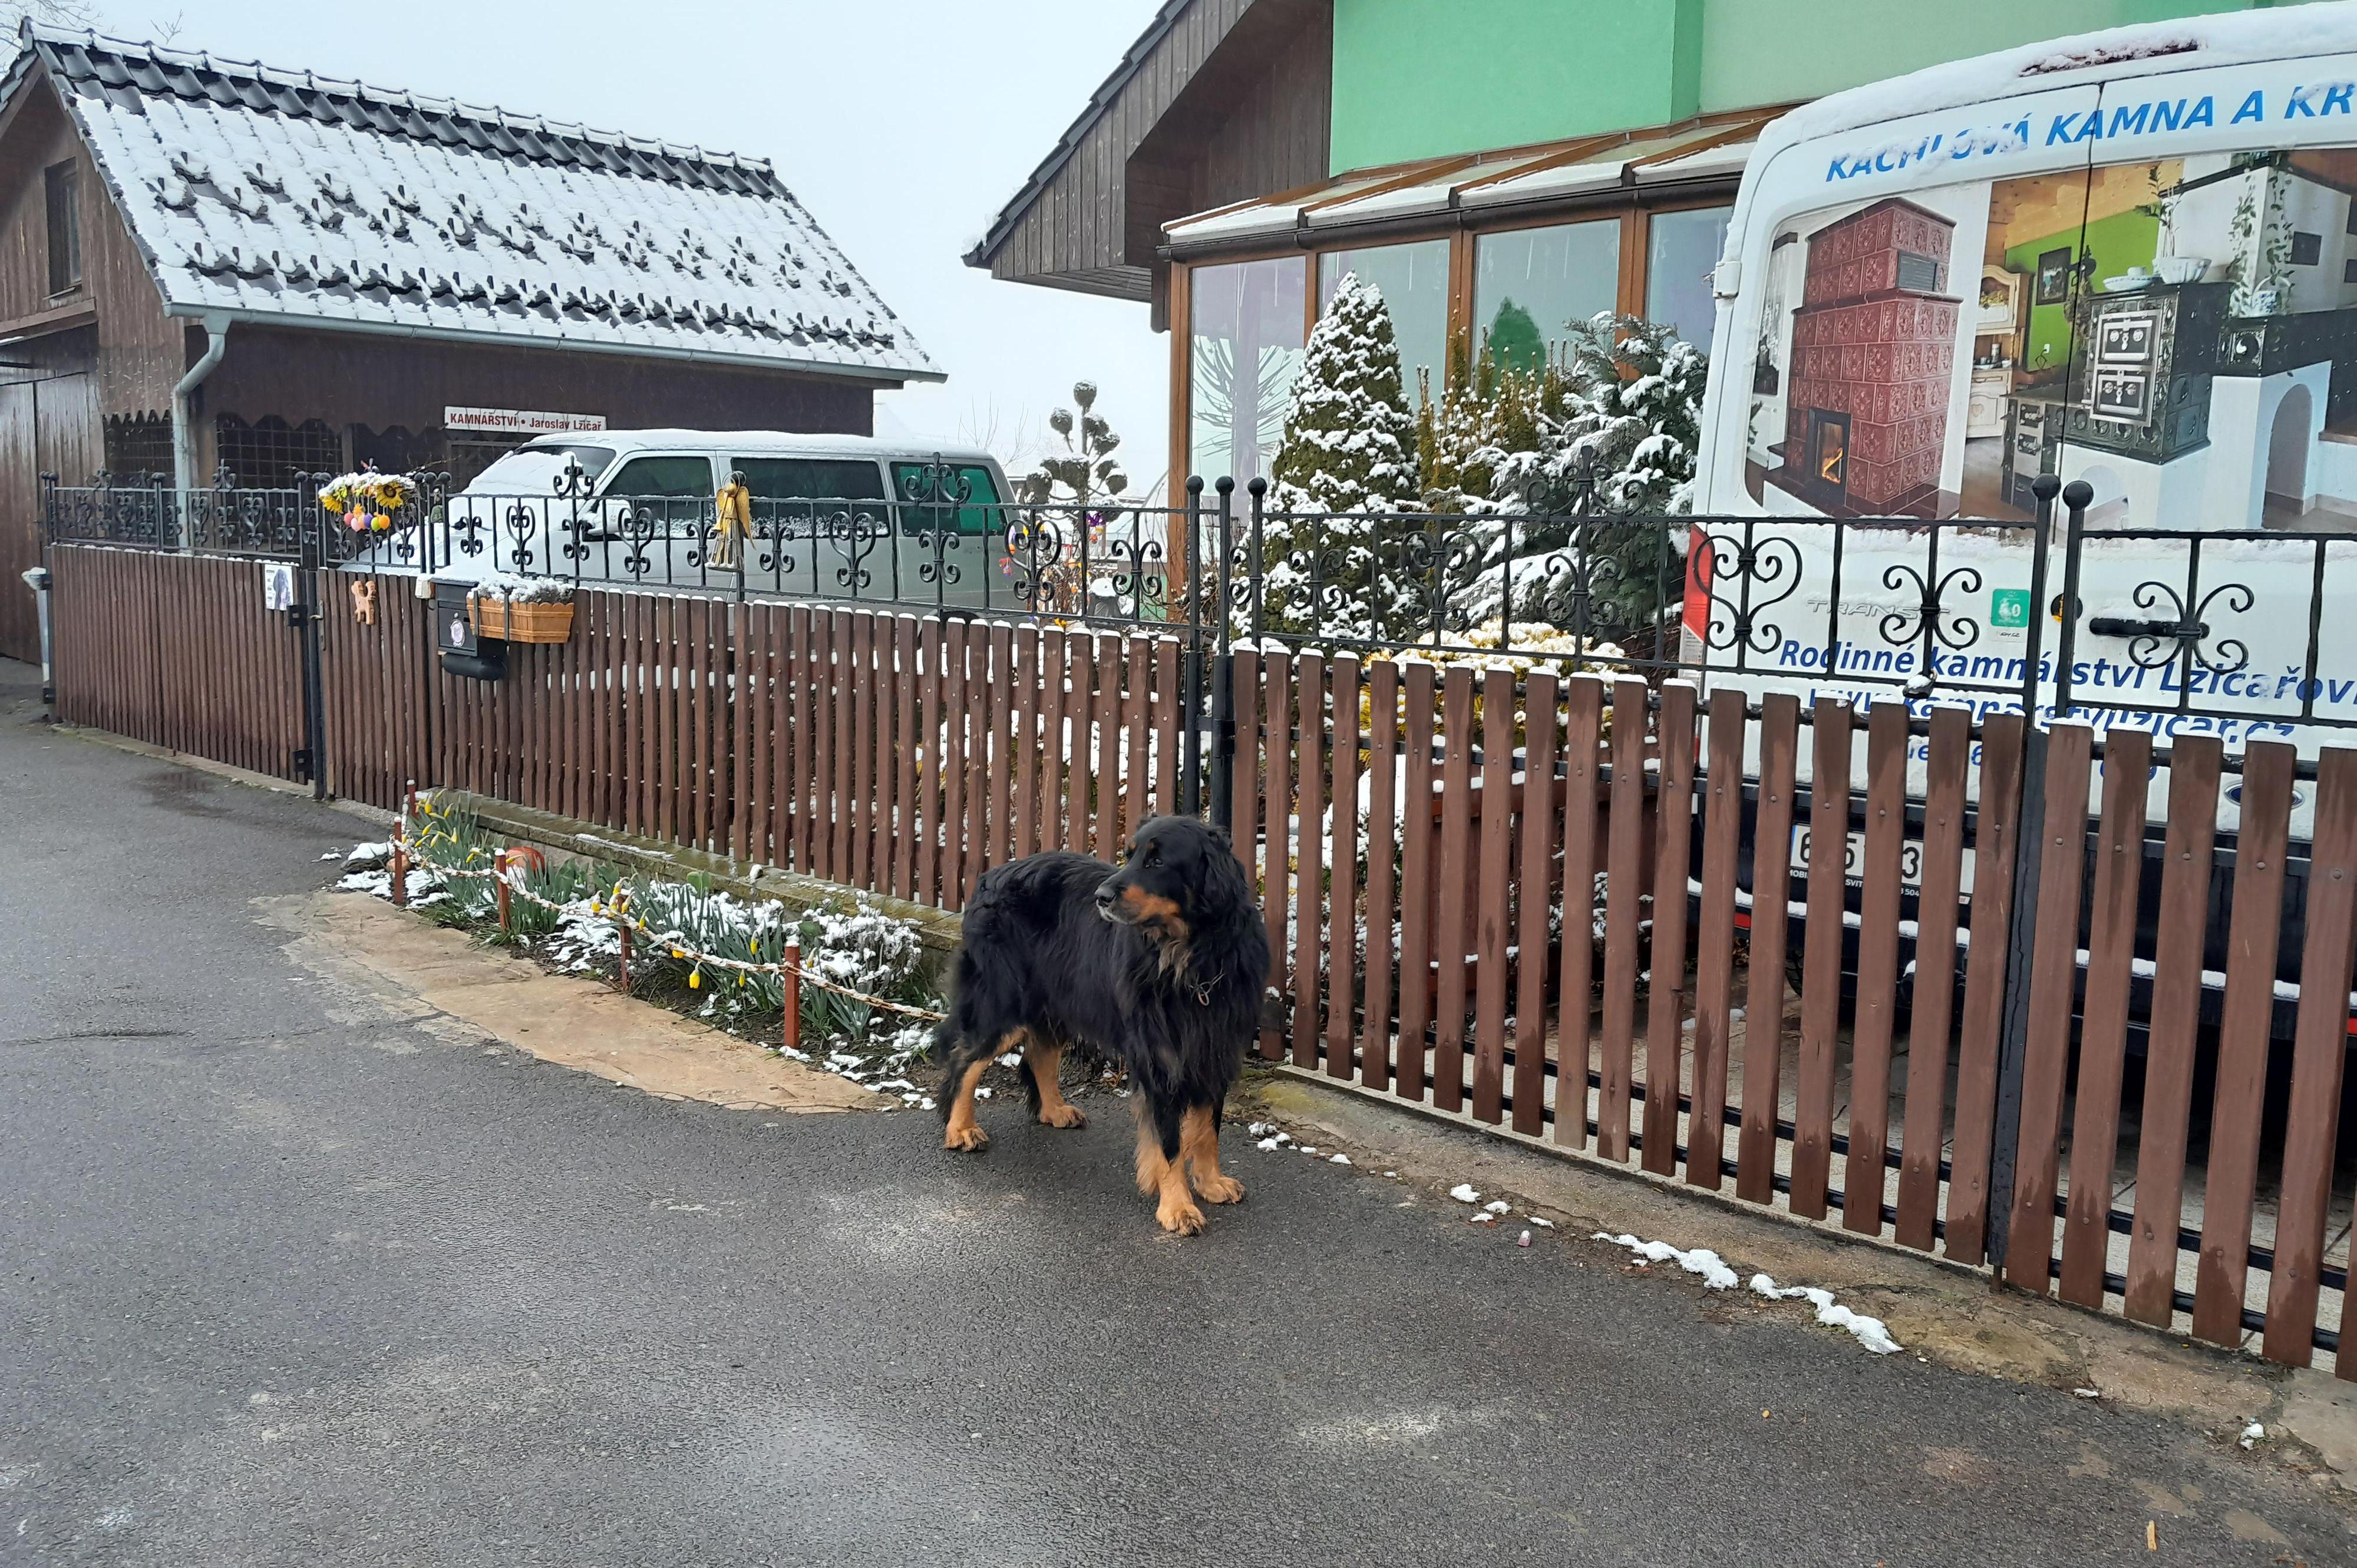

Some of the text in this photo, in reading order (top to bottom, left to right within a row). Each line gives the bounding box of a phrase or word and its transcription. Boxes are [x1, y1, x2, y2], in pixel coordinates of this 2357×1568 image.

[2045, 95, 2214, 146] KAMNA
[2230, 90, 2263, 124] A
[450, 411, 602, 431] KAMNÁŘSTVÍ Jaroslav Lžičař
[1807, 599, 1951, 620] TRANS
[1779, 639, 1917, 674] Rodinné
[1929, 646, 2153, 689] kamnáství
